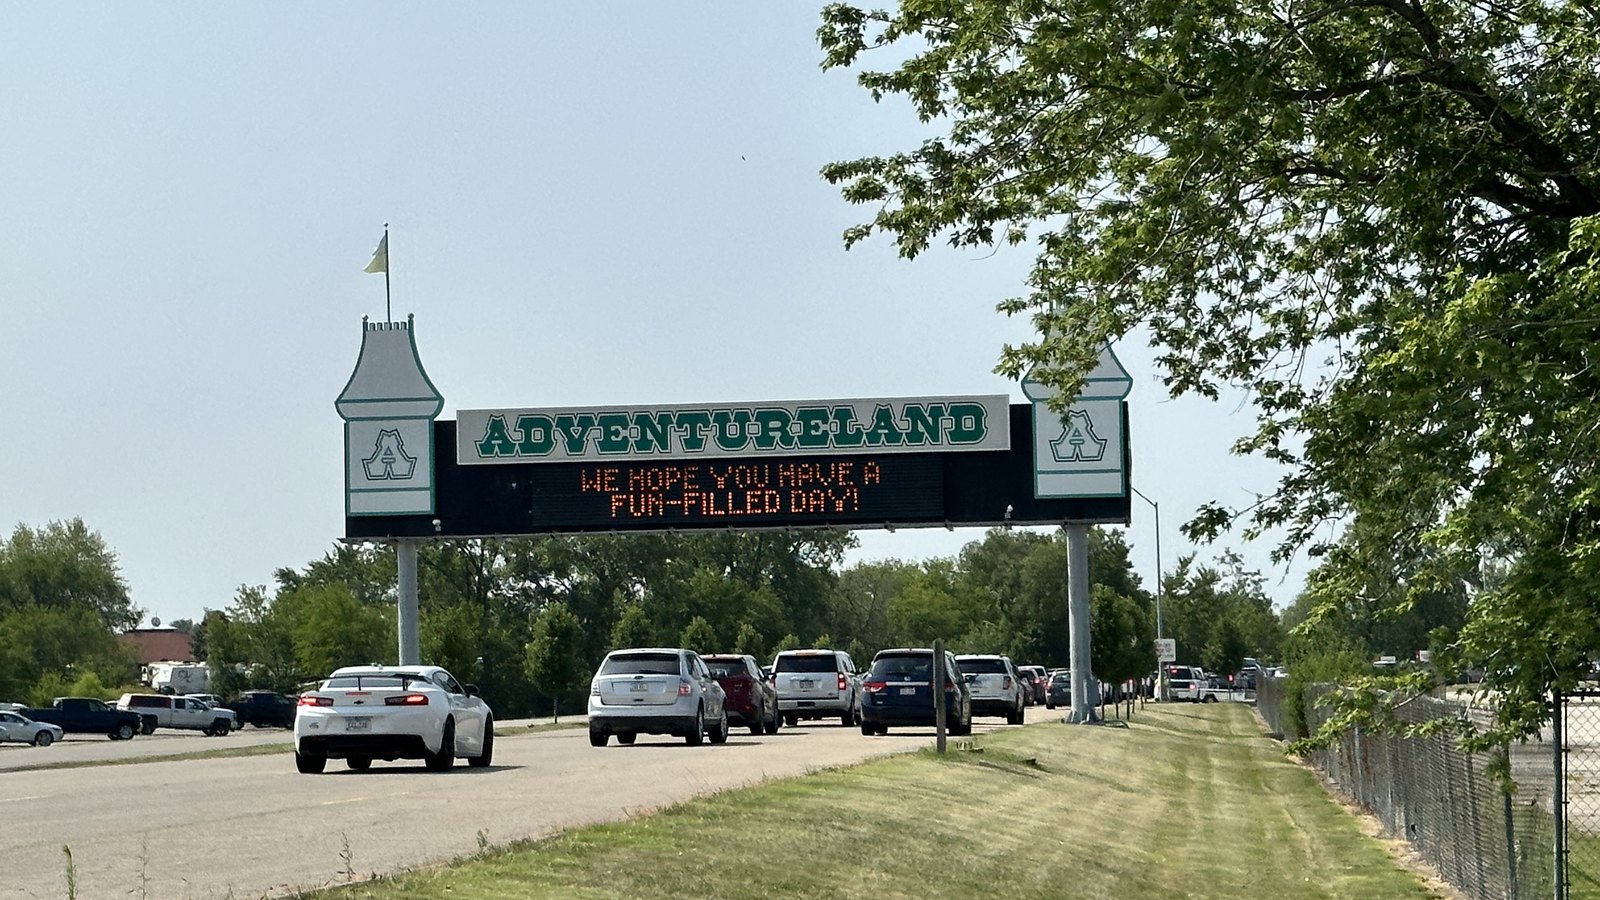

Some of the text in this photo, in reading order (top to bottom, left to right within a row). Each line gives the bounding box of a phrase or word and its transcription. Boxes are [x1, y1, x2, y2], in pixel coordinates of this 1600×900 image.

[362, 428, 418, 481] A
[474, 403, 988, 458] ADVENTURELAND
[1049, 409, 1108, 463] A
[581, 461, 880, 492] WE HOPE YOU HAVE A
[611, 488, 859, 517] FUN-FILLED DAY!
